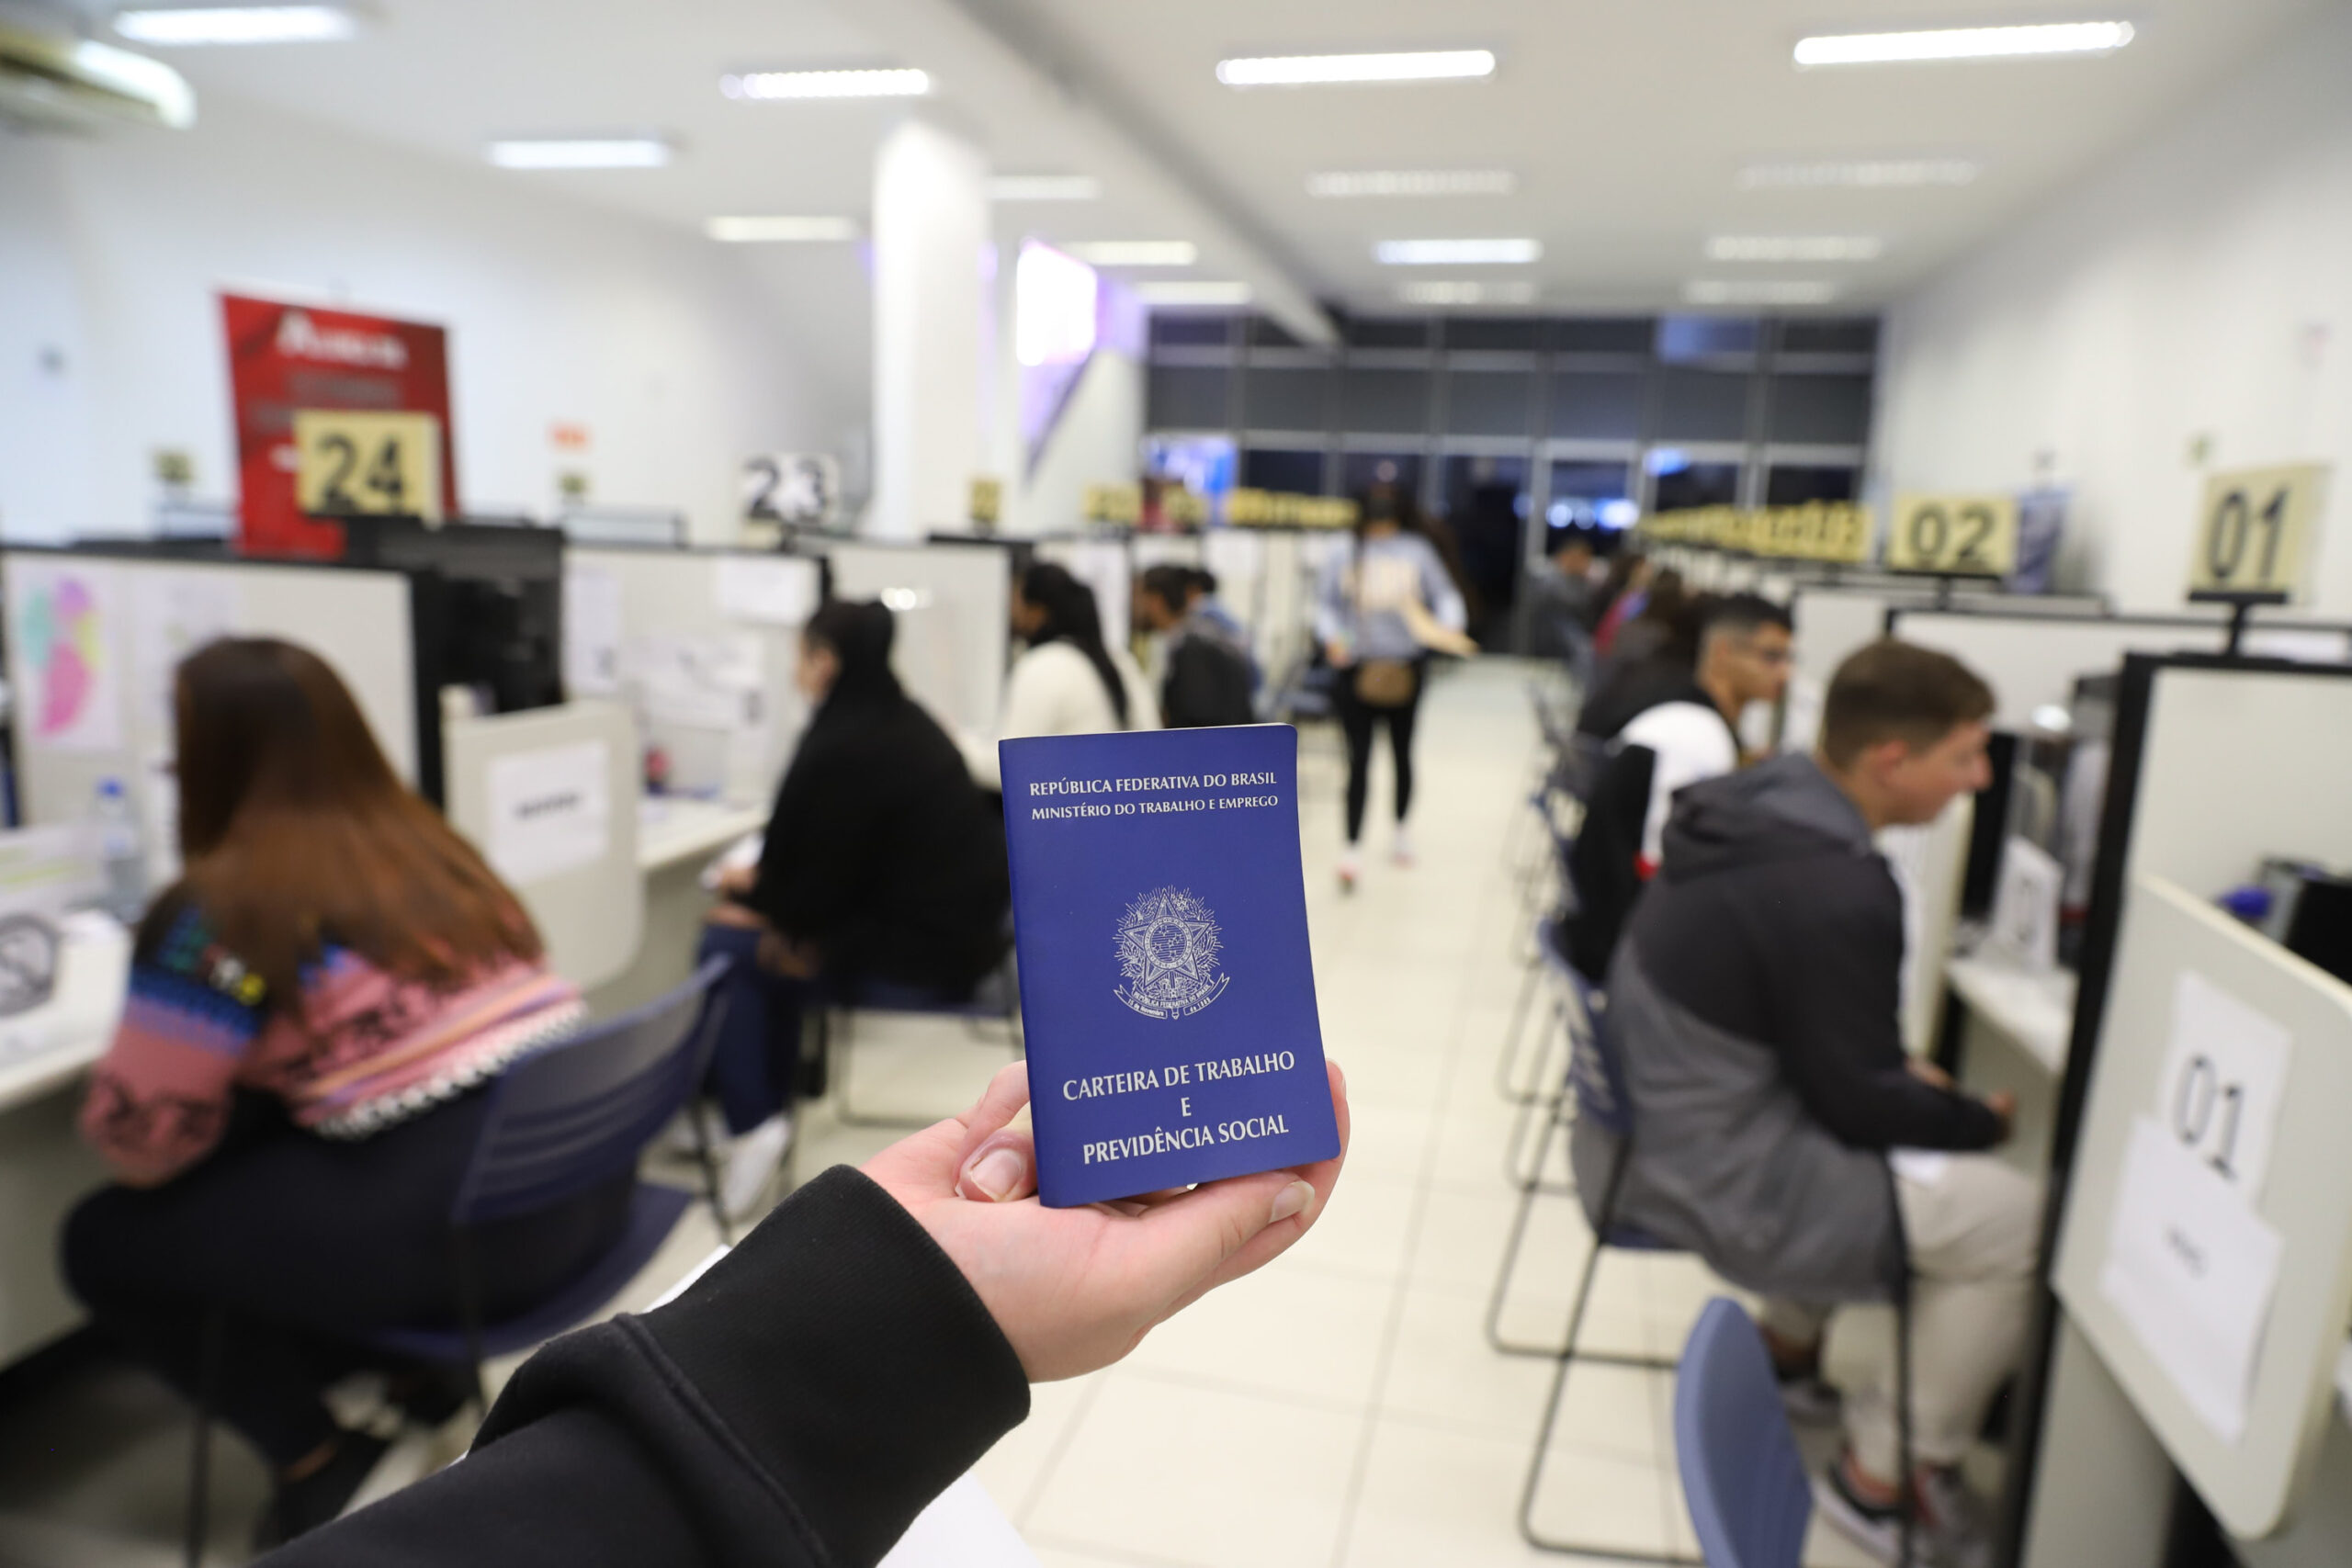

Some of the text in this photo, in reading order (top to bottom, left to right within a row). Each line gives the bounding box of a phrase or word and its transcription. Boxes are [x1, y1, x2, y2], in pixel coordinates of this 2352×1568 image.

[315, 432, 406, 513] 24
[1908, 502, 1996, 570] 02
[2209, 484, 2293, 585] 01
[1029, 772, 1277, 796] REPÚBLICA FEDERATIVA DO BRASIL
[1031, 795, 1279, 820] MINISTÉRIO DO TRABALHO E EMPREGO
[1062, 1051, 1295, 1100] CARTEIRA DE TRABALHO
[1181, 1097, 1192, 1117] E
[2172, 1053, 2245, 1183] 01
[1082, 1114, 1289, 1165] PREVIDÊNCIA SOCIAL
